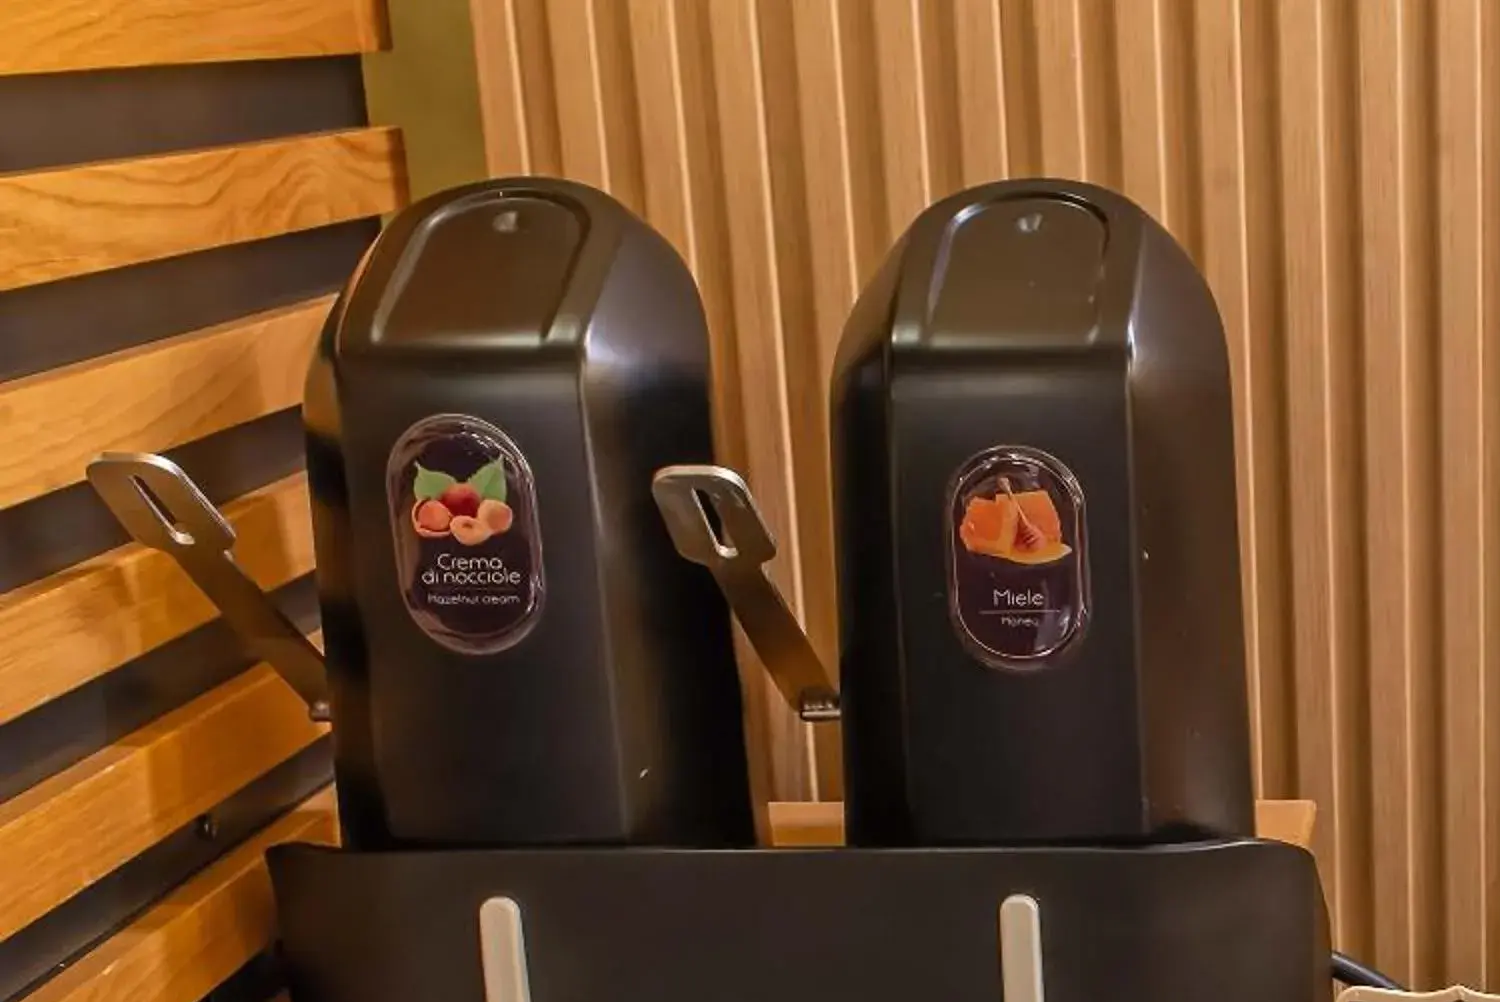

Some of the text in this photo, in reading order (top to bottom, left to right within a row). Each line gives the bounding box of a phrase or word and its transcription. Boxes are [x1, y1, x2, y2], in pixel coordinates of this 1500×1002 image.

[436, 553, 503, 570] Crema
[421, 568, 522, 585] di nocciole
[993, 588, 1045, 607] Miele
